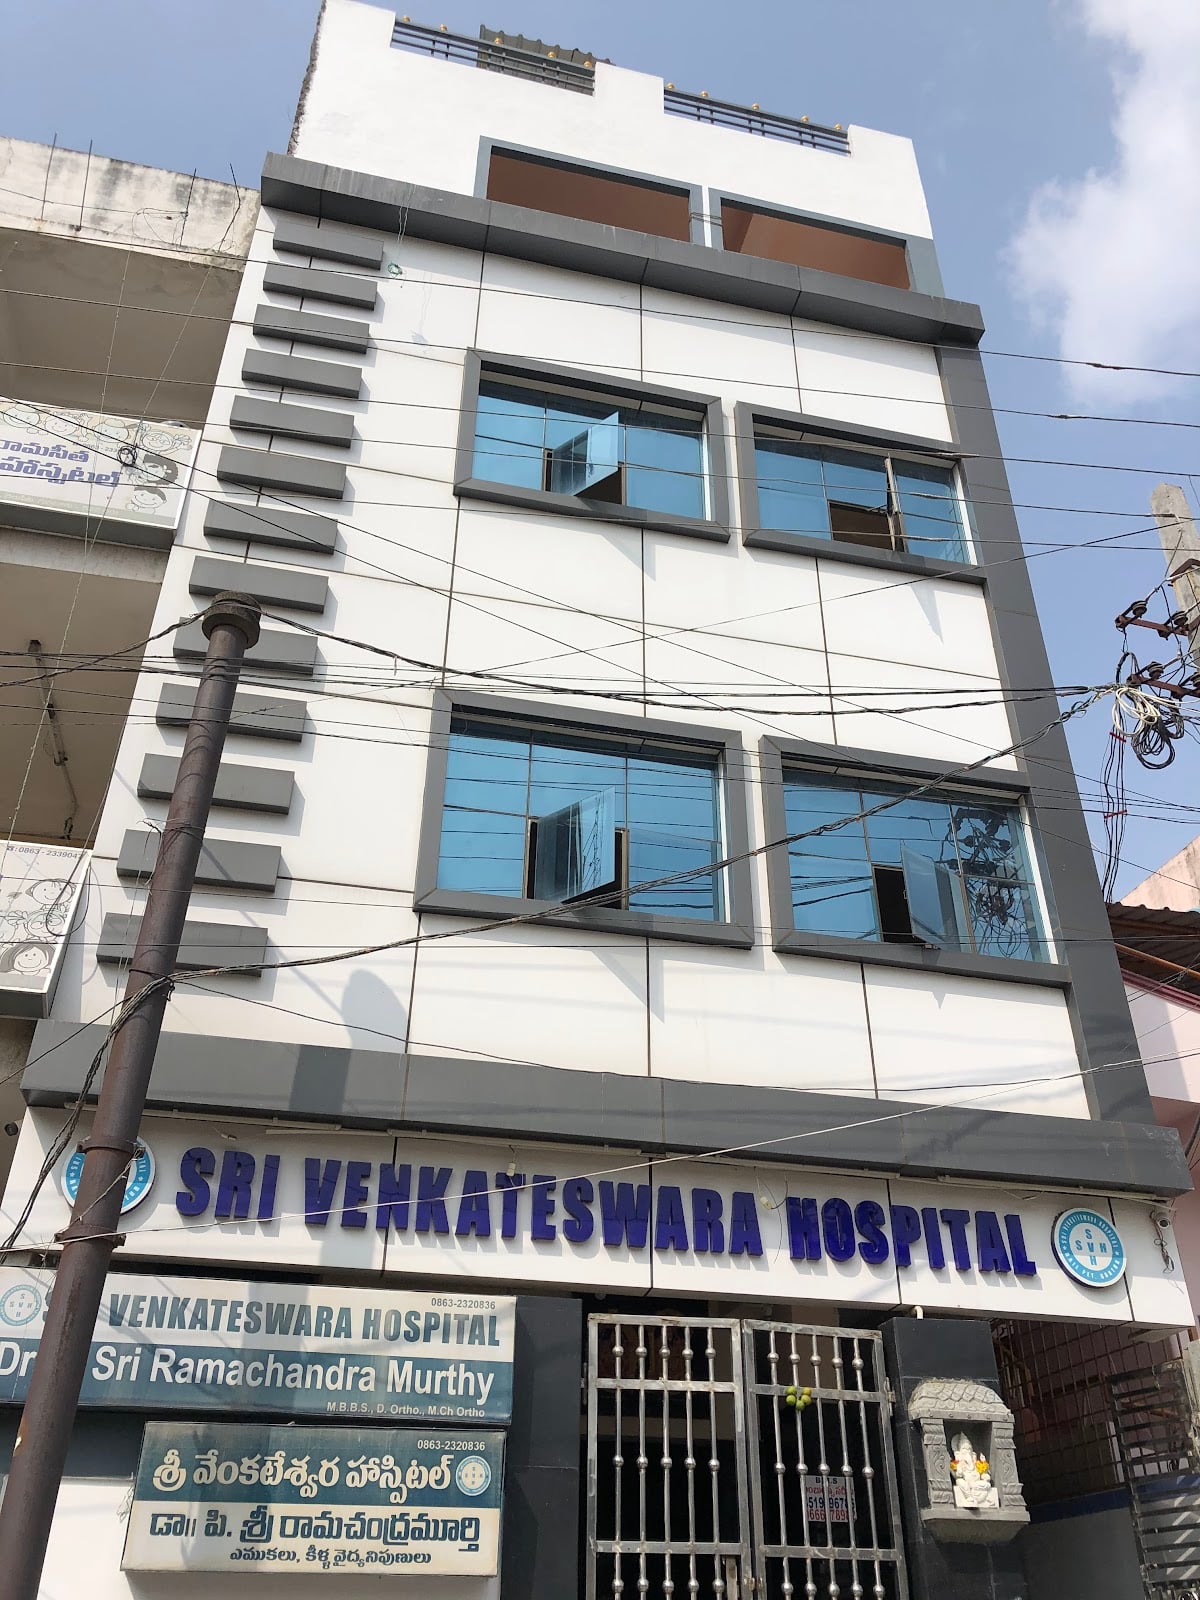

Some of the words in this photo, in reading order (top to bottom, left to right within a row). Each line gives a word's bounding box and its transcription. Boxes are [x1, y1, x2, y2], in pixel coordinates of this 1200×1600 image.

[175, 1146, 281, 1222] SRI
[304, 1157, 764, 1257] VENKATESWARA
[786, 1196, 1037, 1278] HOSPITAL
[108, 1293, 353, 1339] VENKATESWARA
[361, 1307, 501, 1347] HOSPITAL
[431, 1297, 496, 1310] 0863-2320836
[91, 1345, 142, 1382] Sri
[149, 1347, 376, 1392] Ramachandra
[386, 1358, 495, 1406] Murthy
[326, 1401, 374, 1414] M.B.B.S.,
[427, 1405, 454, 1416] M.Ch
[456, 1406, 485, 1418] Ortho
[417, 1439, 486, 1451] 0863-2320836
[152, 1448, 188, 1492] శ్రీ
[192, 1448, 341, 1499] వేంకటేశ్వర
[345, 1454, 455, 1504] హాస్పిటల్
